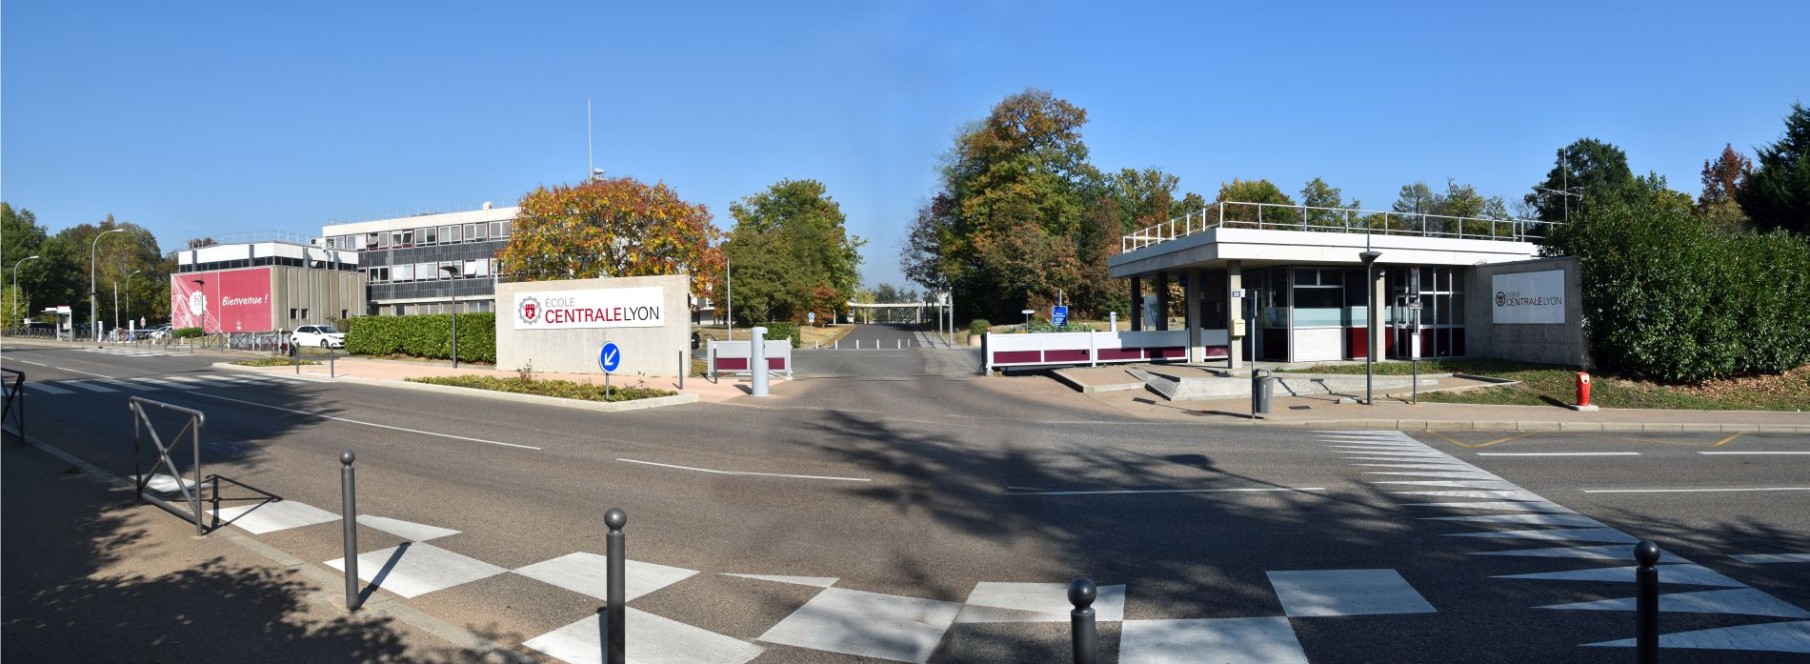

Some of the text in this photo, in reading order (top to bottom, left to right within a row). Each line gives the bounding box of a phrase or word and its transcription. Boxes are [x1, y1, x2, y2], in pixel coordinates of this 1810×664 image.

[194, 295, 202, 303] 50
[222, 296, 262, 306] Bienvenue
[545, 297, 575, 307] ÉCOLE
